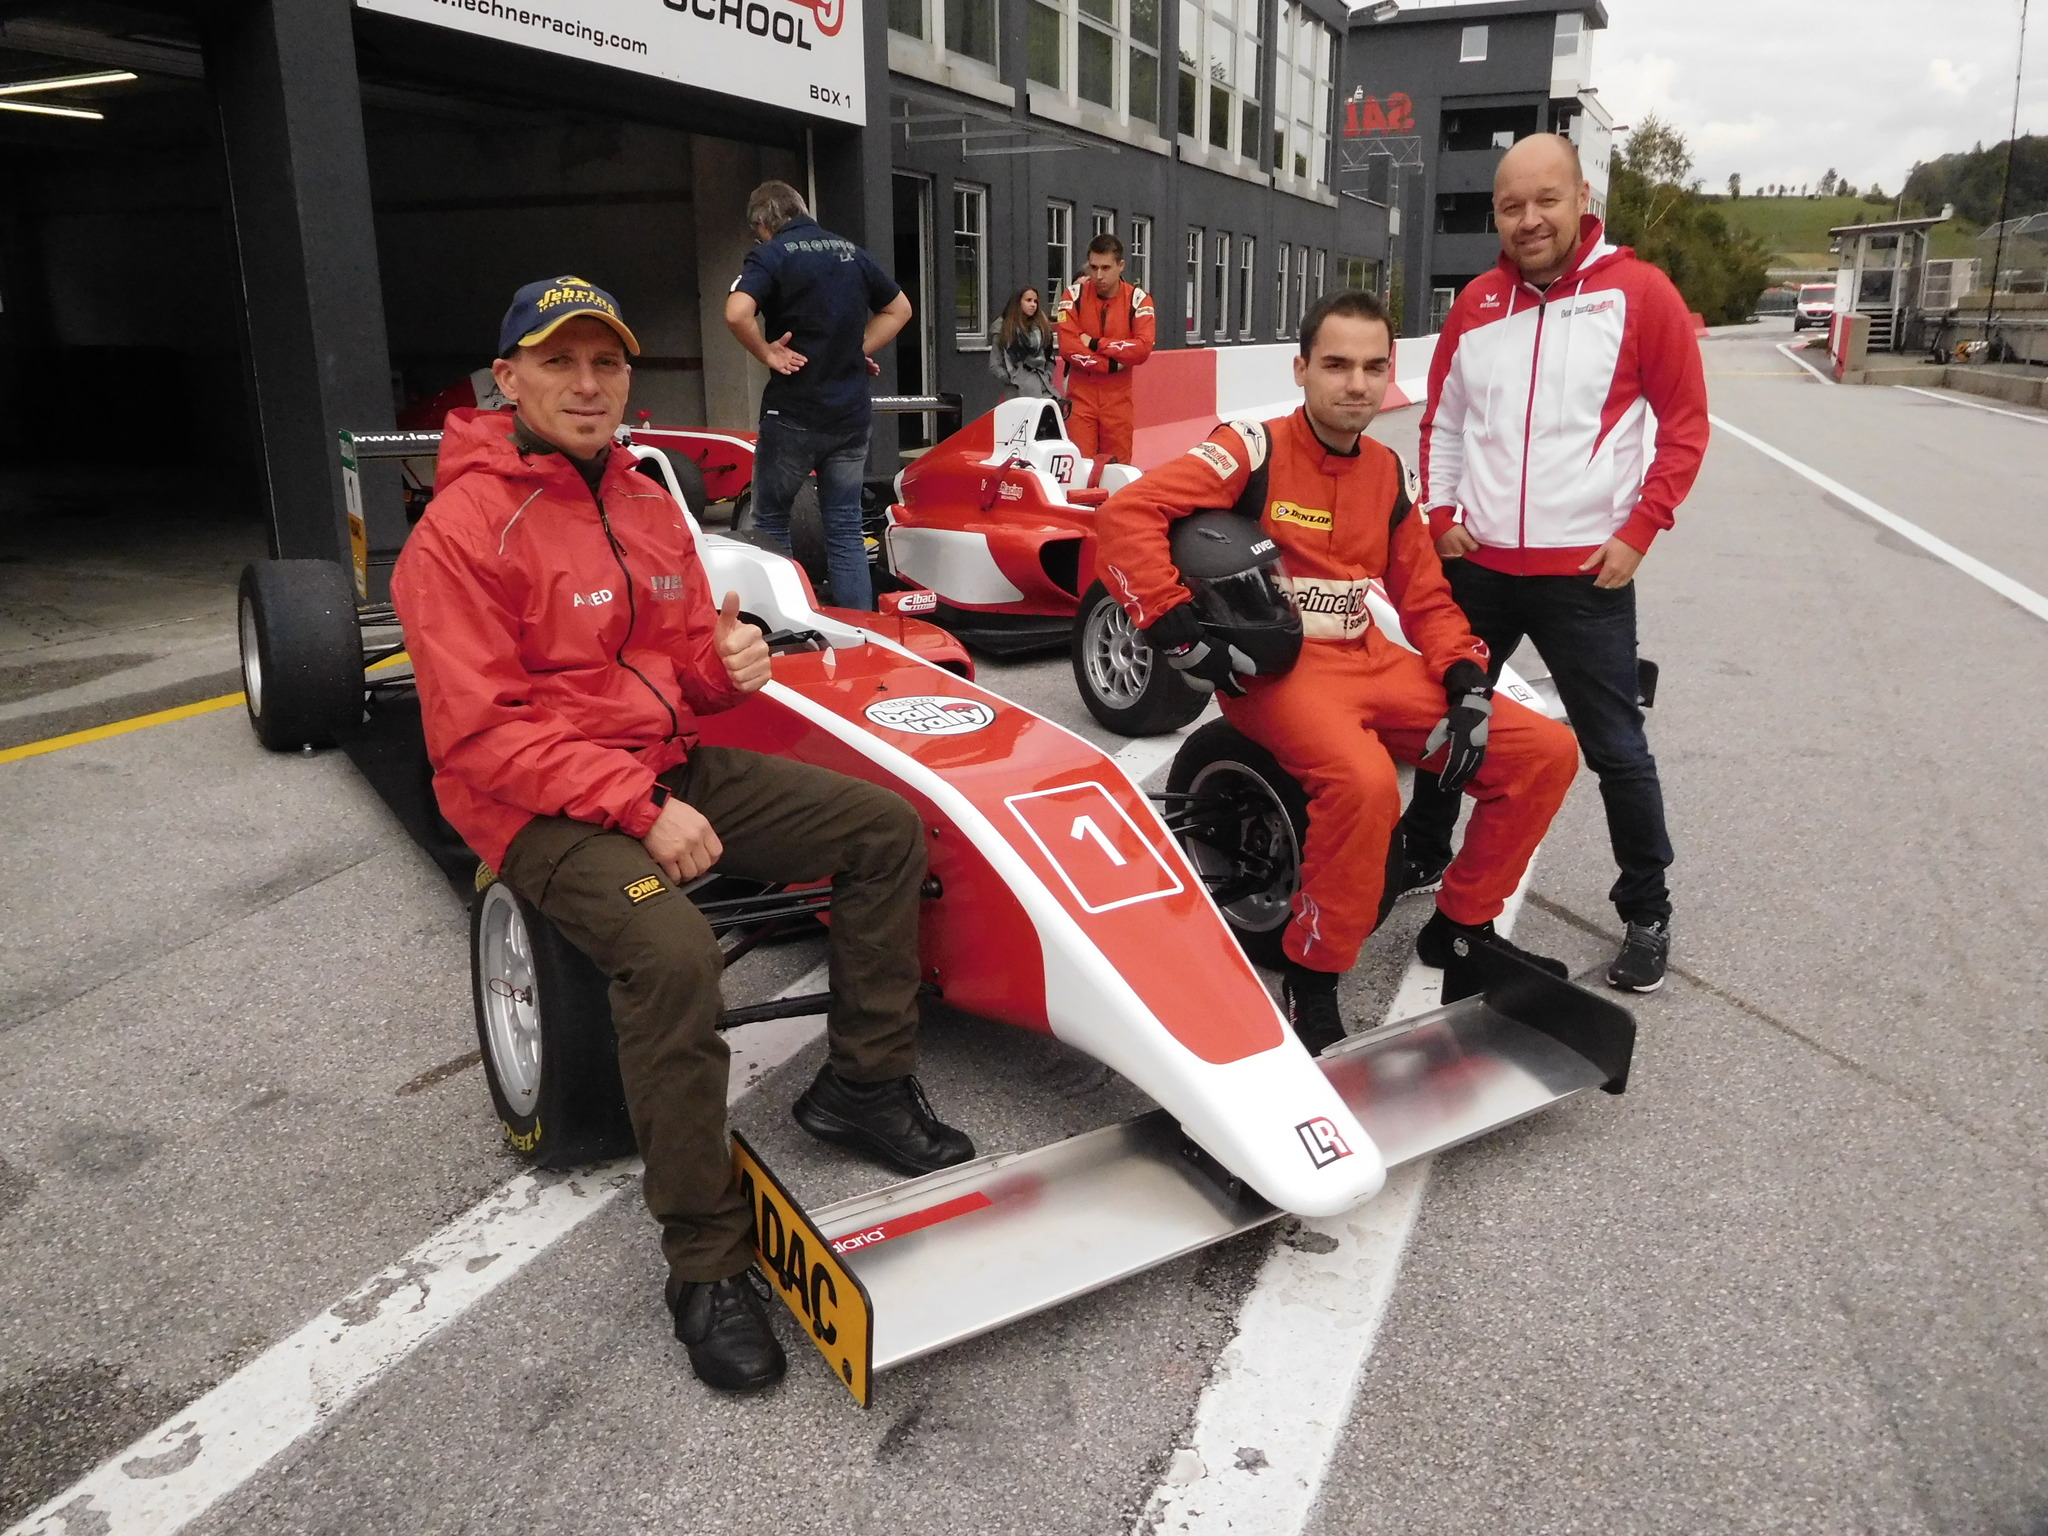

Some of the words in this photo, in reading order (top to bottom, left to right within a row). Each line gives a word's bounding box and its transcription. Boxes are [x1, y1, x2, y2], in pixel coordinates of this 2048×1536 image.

[810, 84, 841, 106] BOX
[845, 95, 851, 108] 1
[536, 287, 616, 317] Sebring
[354, 432, 444, 443] www.lec
[898, 592, 936, 611] Eibach
[904, 705, 987, 732] rally
[1070, 815, 1127, 866] 1
[628, 879, 660, 898] OMP
